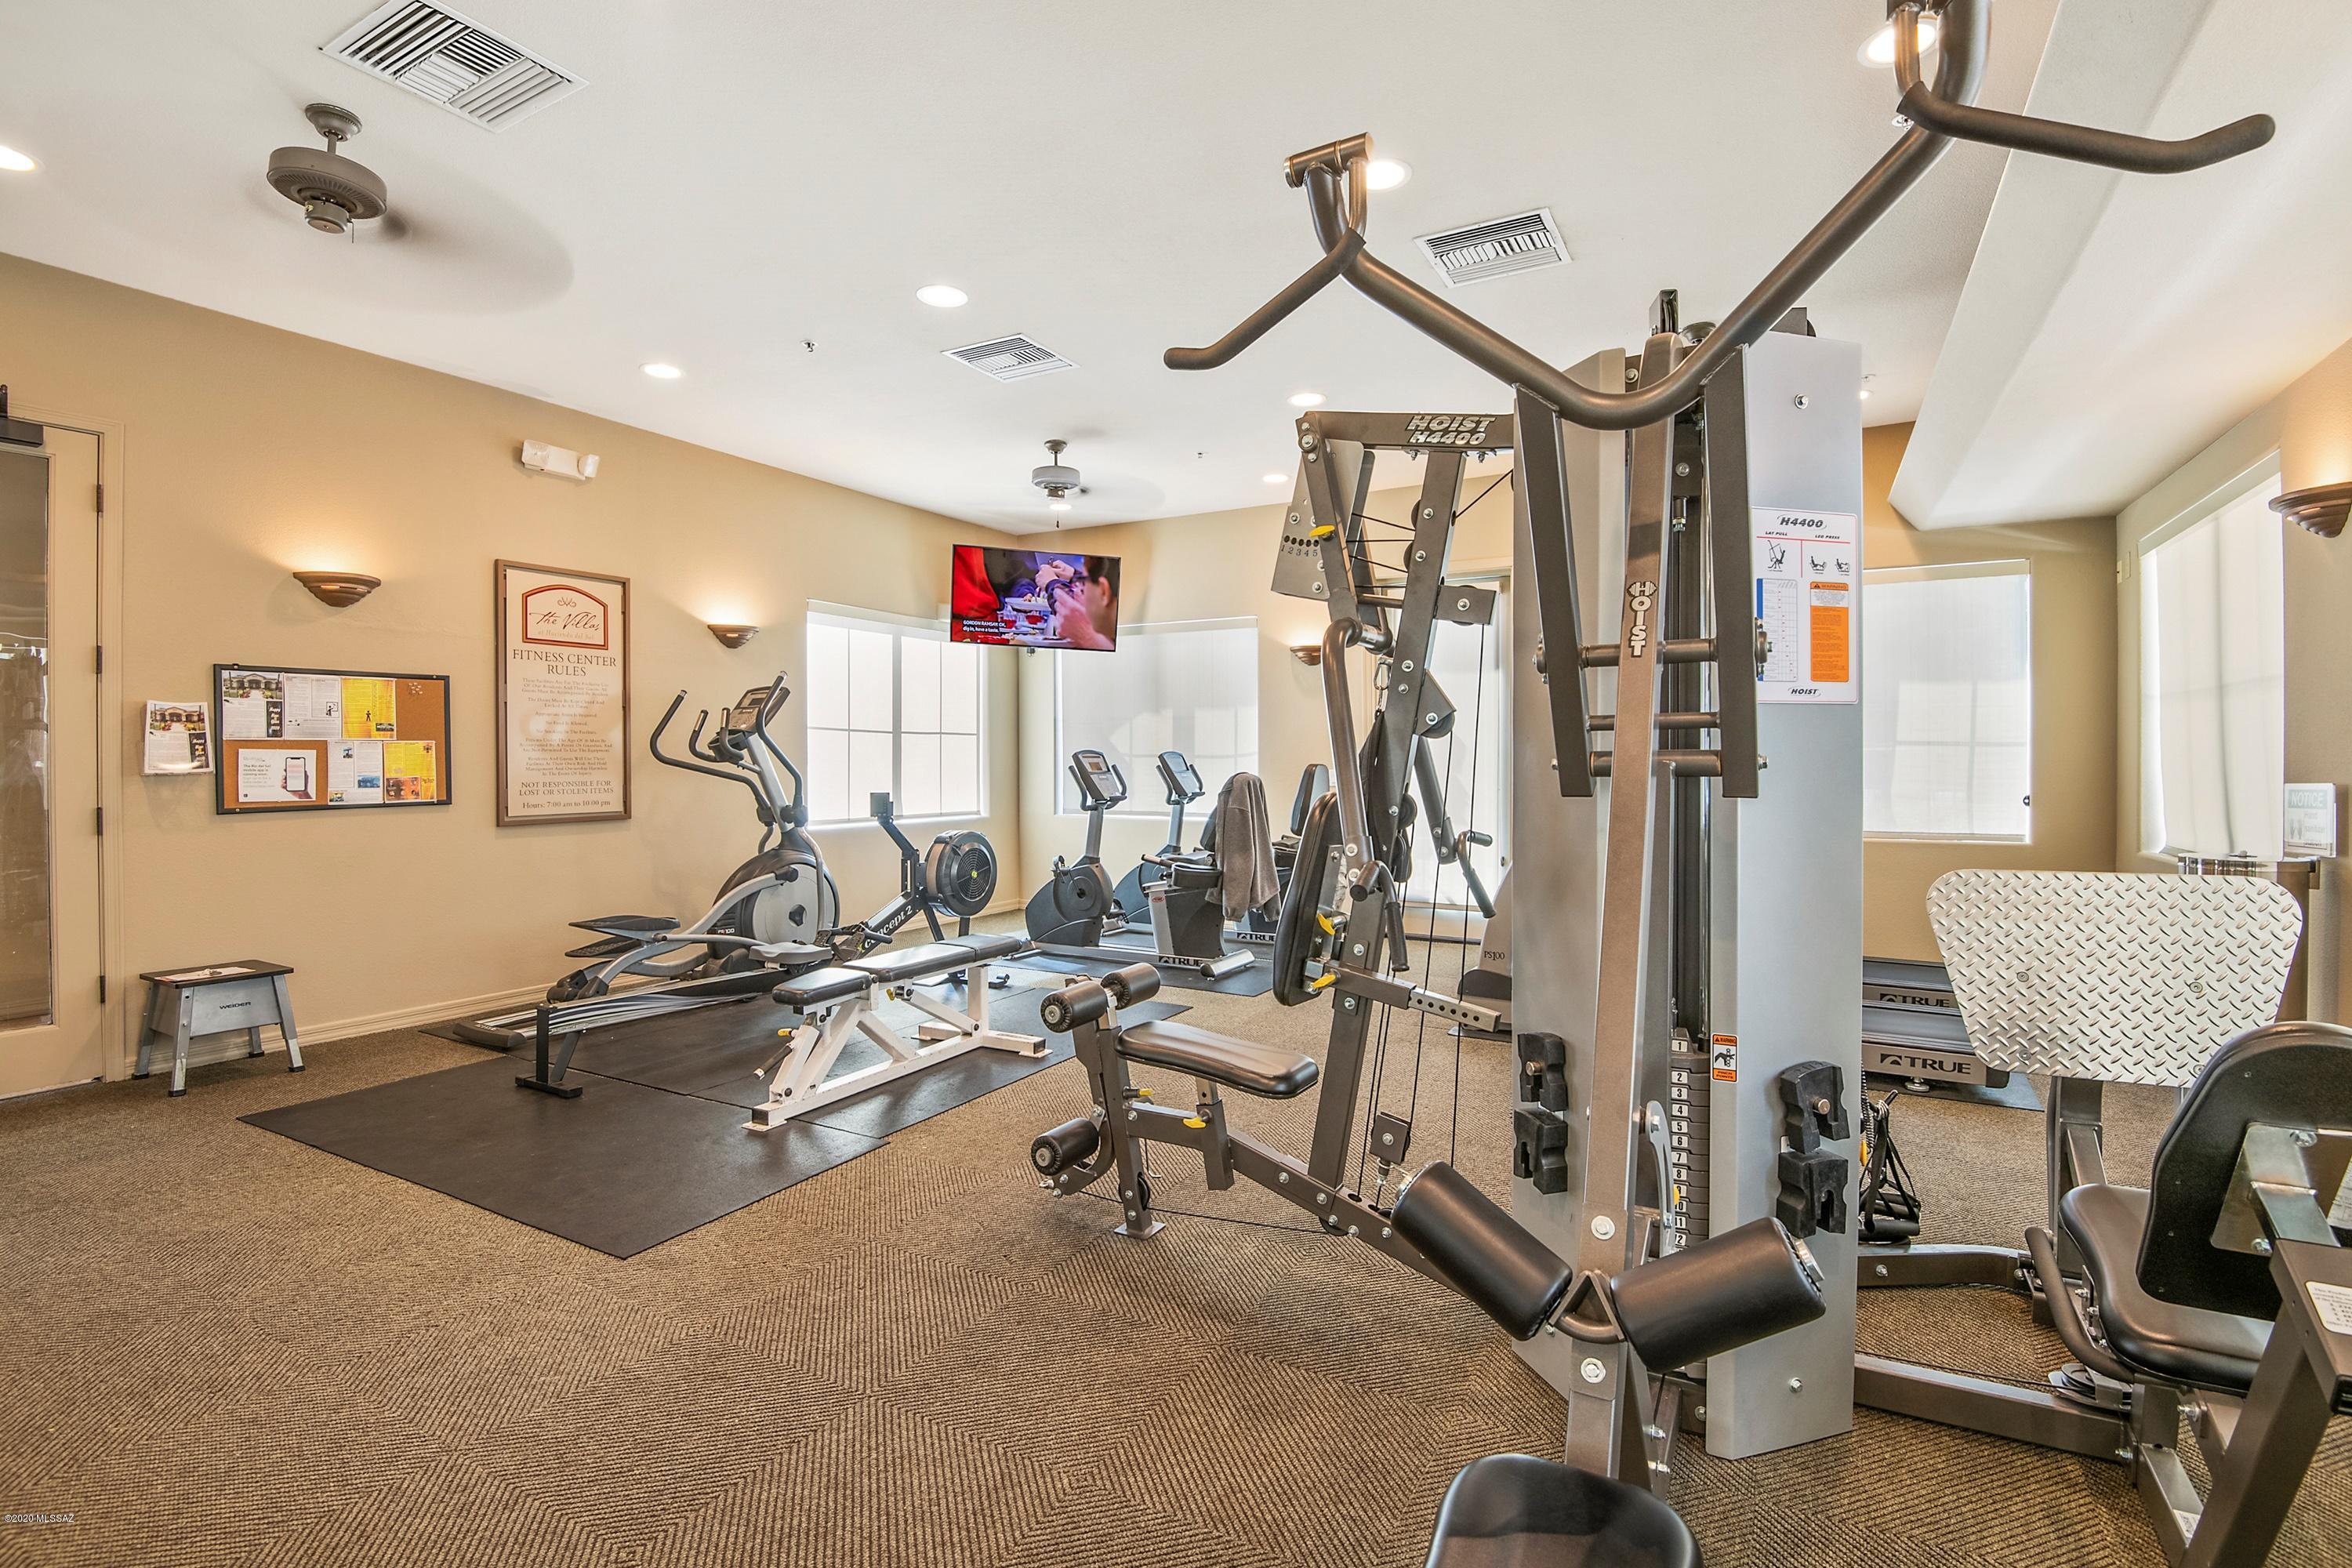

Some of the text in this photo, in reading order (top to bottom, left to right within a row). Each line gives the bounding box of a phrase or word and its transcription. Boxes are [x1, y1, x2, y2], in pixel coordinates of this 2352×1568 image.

[1406, 415, 1496, 432] HOIST
[1409, 431, 1486, 445] H4400
[1780, 517, 1824, 528] H4400
[529, 612, 561, 625] The
[1627, 580, 1658, 658] HOIST
[513, 649, 616, 666] FITNESS CENTER
[547, 665, 586, 677] RULES
[2291, 791, 2325, 807] NOTICE
[906, 905, 913, 915] 2
[1484, 951, 1504, 960] PS100
[1171, 957, 1203, 967] TRUE
[220, 1001, 252, 1010] WEIDER
[1897, 995, 1951, 1007] TRUE
[1677, 1041, 1682, 1051] 1
[1904, 1056, 1971, 1075] TRUE
[1677, 1073, 1682, 1081] 2
[1677, 1088, 1682, 1097] 3
[1677, 1105, 1682, 1114] 4
[1677, 1122, 1682, 1131] 5
[1677, 1137, 1682, 1145] 6
[1677, 1153, 1682, 1162] 7
[1676, 1169, 1682, 1178] 8
